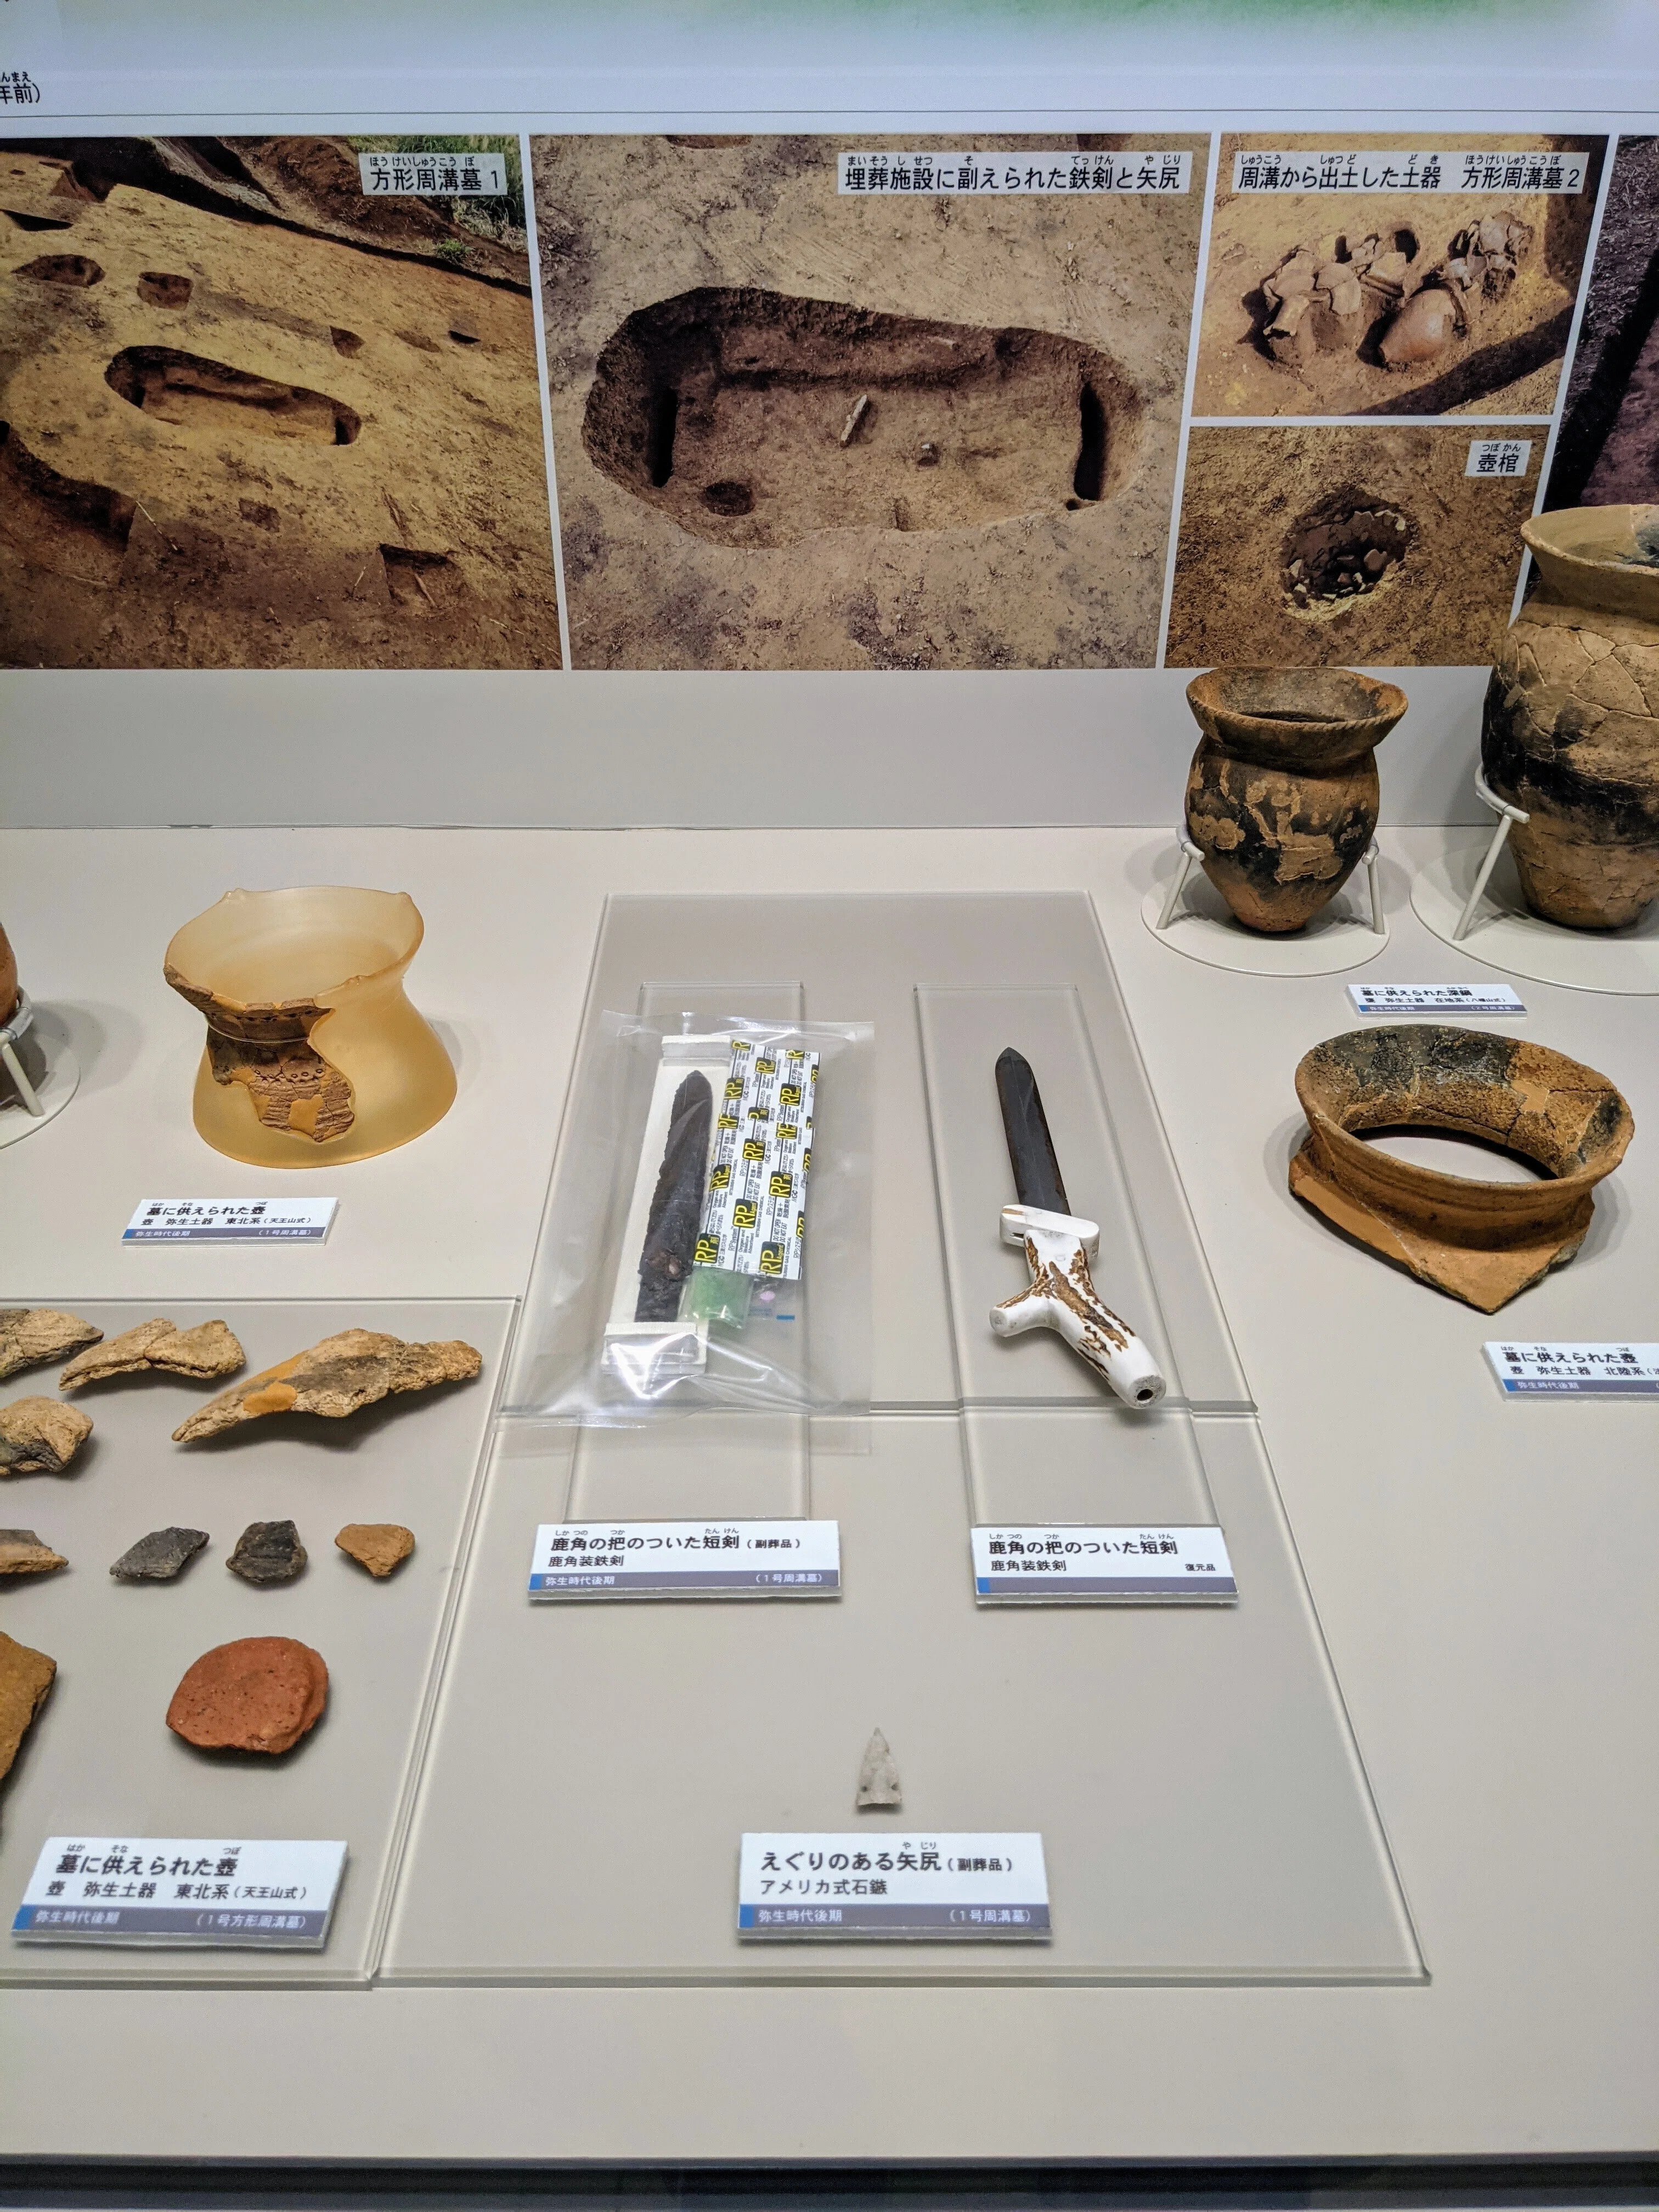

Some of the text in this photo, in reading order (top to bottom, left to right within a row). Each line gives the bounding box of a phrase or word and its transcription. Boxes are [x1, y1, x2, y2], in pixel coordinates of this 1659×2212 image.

[913, 156, 933, 165] せつ
[845, 167, 1180, 191] 埋葬施設に副えられた鉄剣と矢尻
[1238, 166, 1441, 190] 周溝から出土した土器
[724, 1082, 742, 1099] RP
[781, 1087, 800, 1105] RP
[743, 1142, 764, 1161] RP
[710, 1171, 728, 1192] RP
[770, 1176, 791, 1198] RP
[734, 1204, 756, 1228] RP
[695, 1239, 717, 1262] RP
[760, 1250, 783, 1274] RP
[1536, 1366, 1591, 1375] 弥生土器
[989, 1540, 1178, 1555] 鹿角の把のついた短剣
[548, 1555, 624, 1567] 鹿角装鉄剣
[991, 1560, 1216, 1571] 鹿角装鉄剣 復元品
[545, 1576, 614, 1585] 弥生時代後期
[56, 1854, 238, 1876] 墓に供えられた壺
[83, 1881, 157, 1898] 弥生土器
[760, 1878, 888, 1895] アメリカ式石鏃
[758, 1909, 843, 1922] 弥生時代後期
